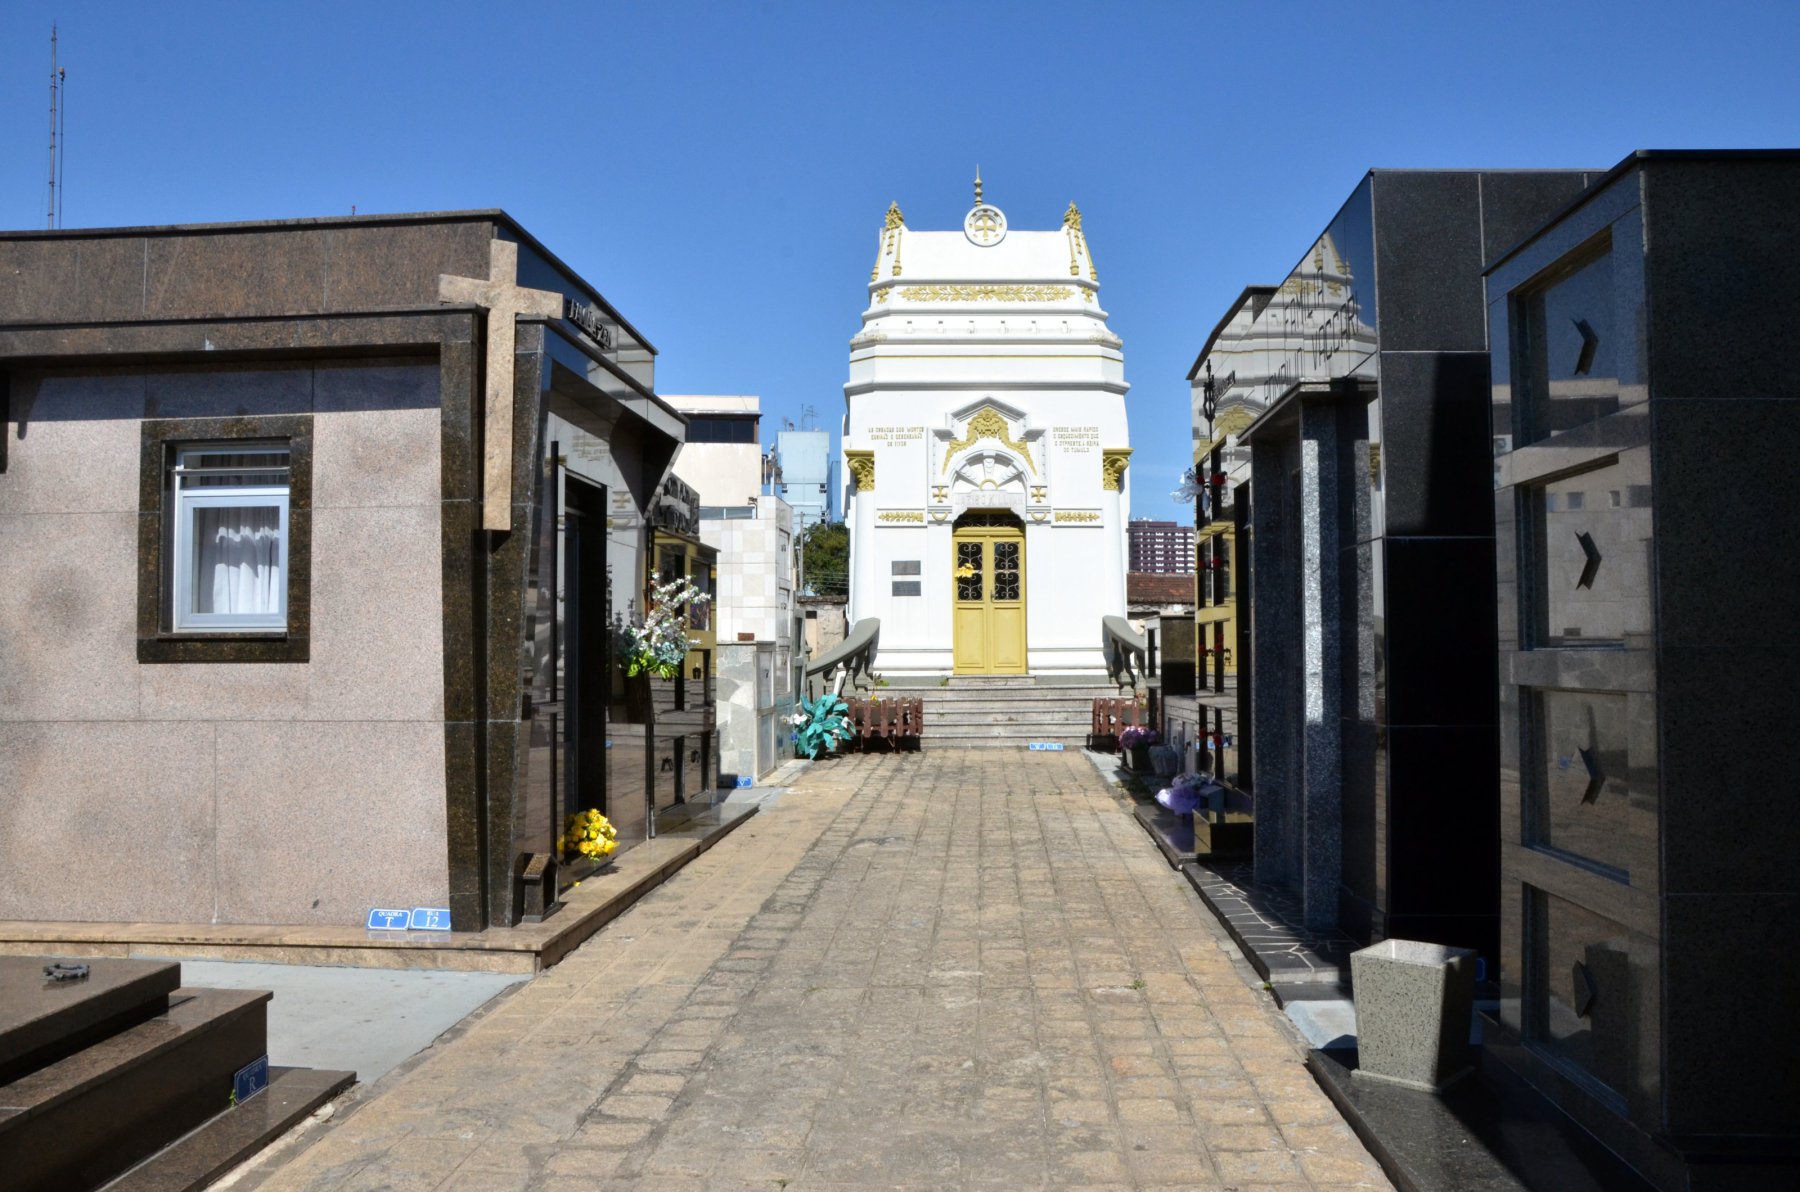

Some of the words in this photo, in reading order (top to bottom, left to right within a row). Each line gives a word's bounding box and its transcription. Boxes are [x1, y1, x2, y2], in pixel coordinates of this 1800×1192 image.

[1285, 266, 1324, 336] FAMILIA
[1311, 289, 1359, 371] VACCARI
[385, 916, 394, 927] T
[425, 916, 439, 927] 12
[249, 1076, 257, 1093] R
